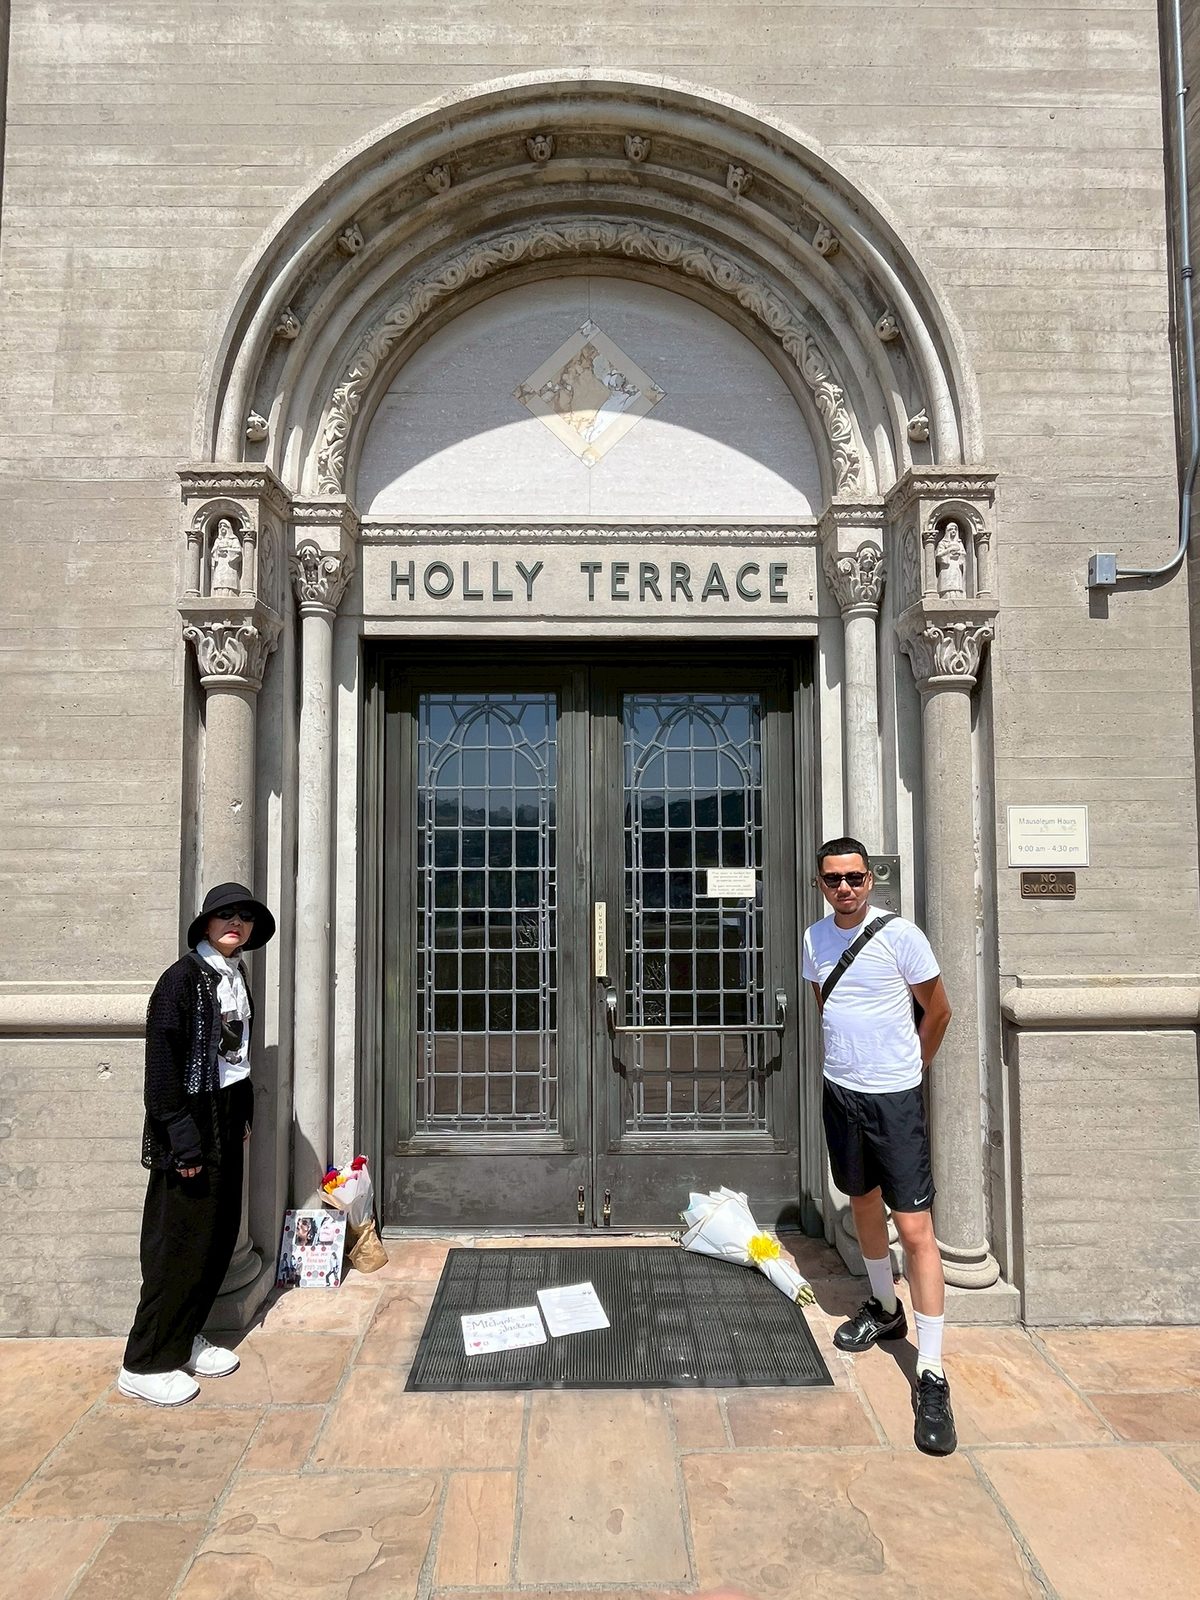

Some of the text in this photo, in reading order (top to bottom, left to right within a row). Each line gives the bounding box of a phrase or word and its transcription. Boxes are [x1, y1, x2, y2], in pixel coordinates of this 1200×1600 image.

[391, 560, 788, 602] HOLLY TERRACE
[1018, 817, 1077, 825] Mausoleum Hours
[1041, 873, 1057, 883] NO
[1023, 884, 1075, 893] SMOKING
